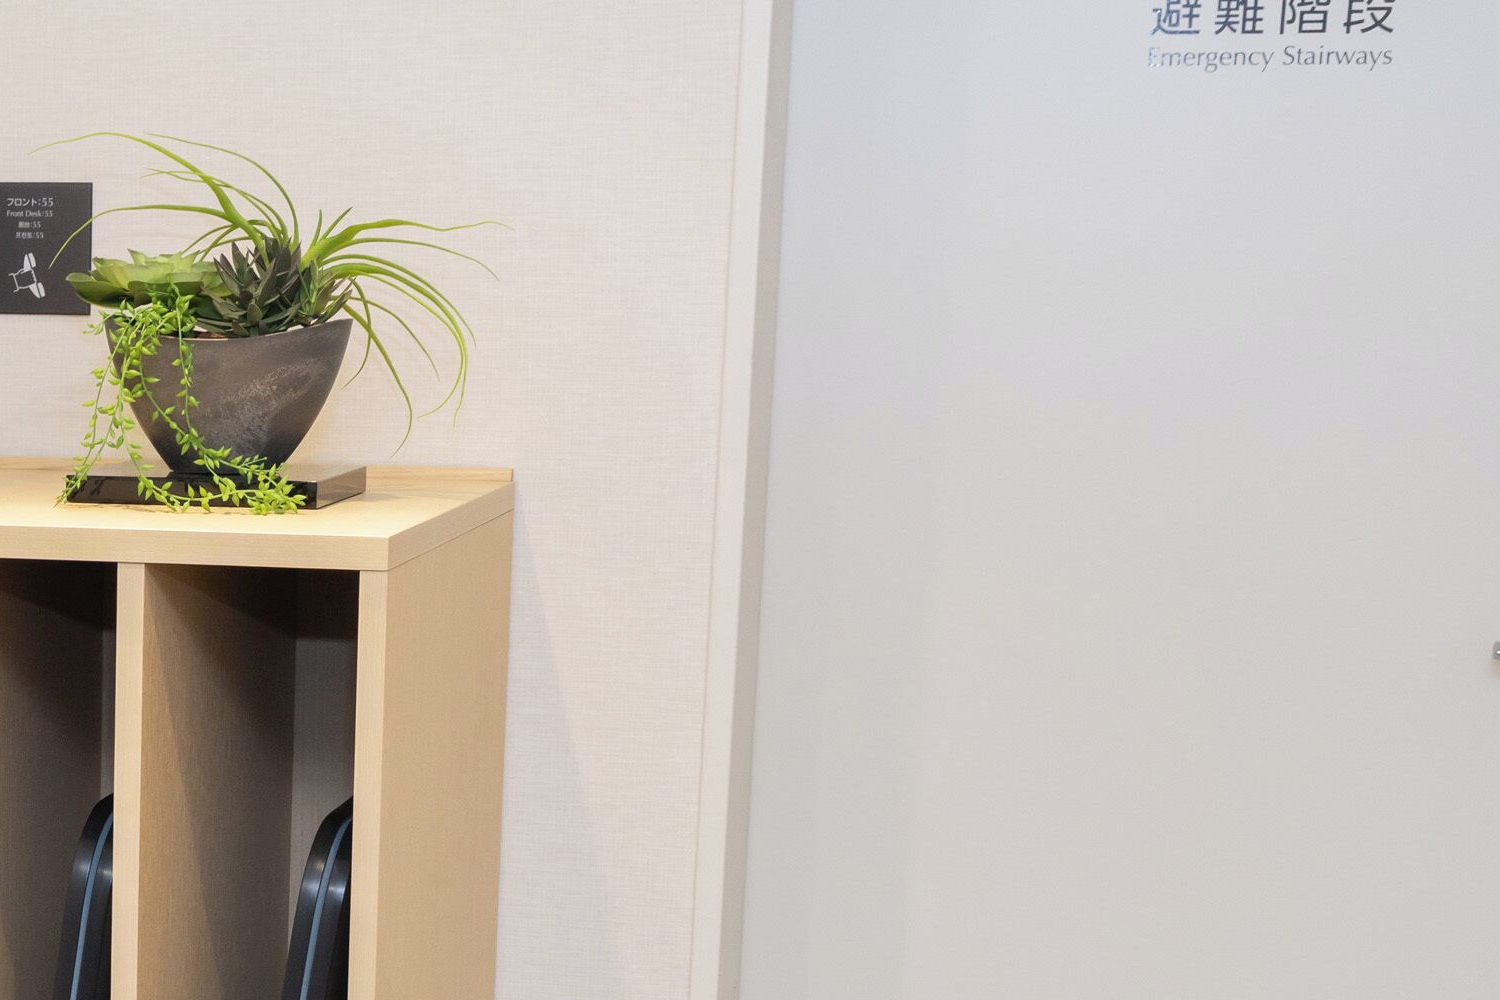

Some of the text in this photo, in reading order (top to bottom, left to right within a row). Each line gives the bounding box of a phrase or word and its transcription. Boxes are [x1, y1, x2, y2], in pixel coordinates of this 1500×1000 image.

[1151, 0, 1394, 35] 避難階段
[1148, 45, 1394, 73] Emergency Stairways
